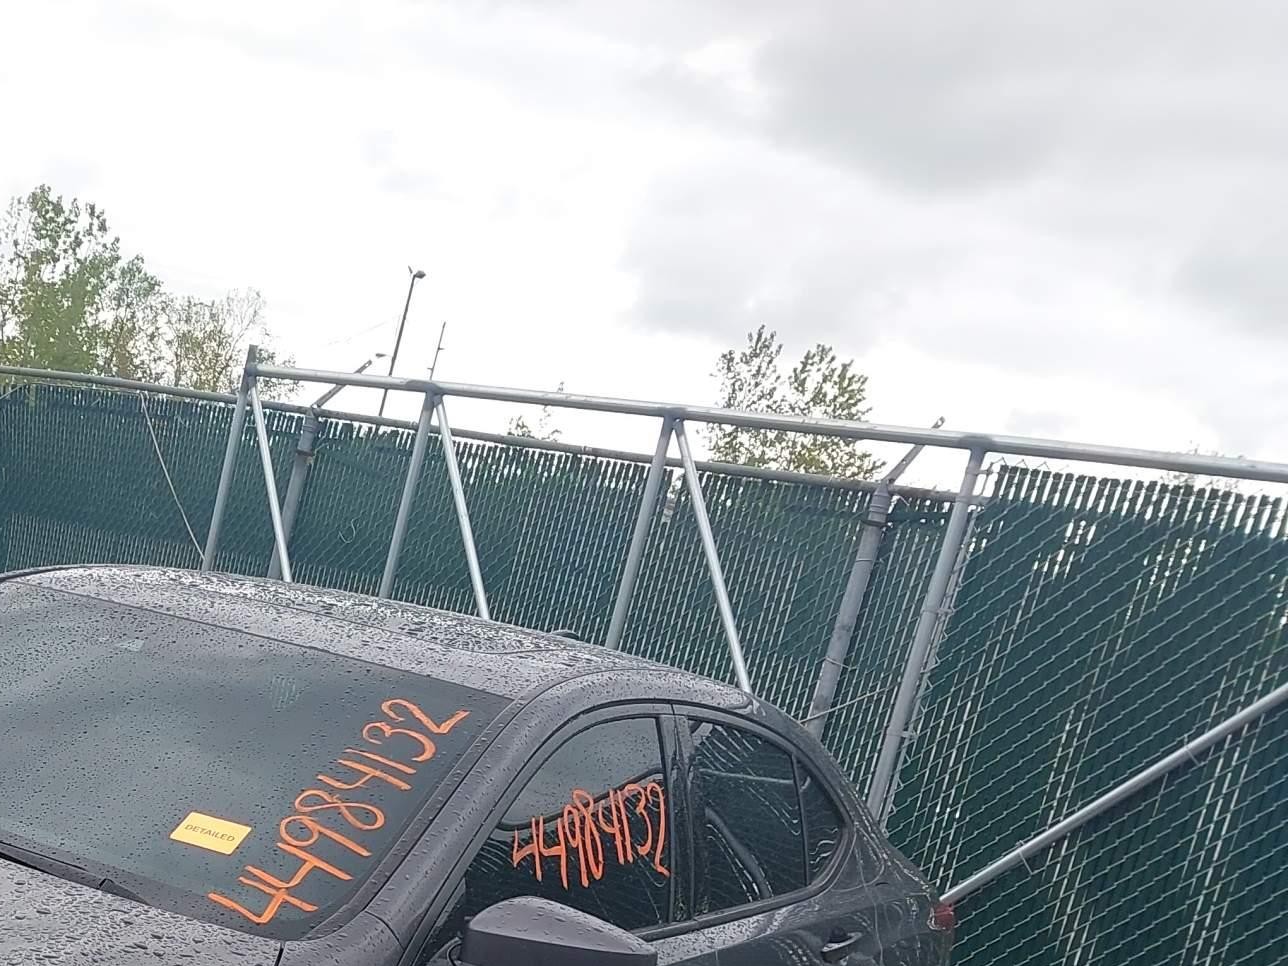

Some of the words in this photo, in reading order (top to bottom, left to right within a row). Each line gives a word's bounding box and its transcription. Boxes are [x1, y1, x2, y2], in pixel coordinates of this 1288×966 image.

[184, 823, 236, 843] DETAILED
[207, 698, 471, 925] 44984132
[512, 782, 671, 890] 44984132
